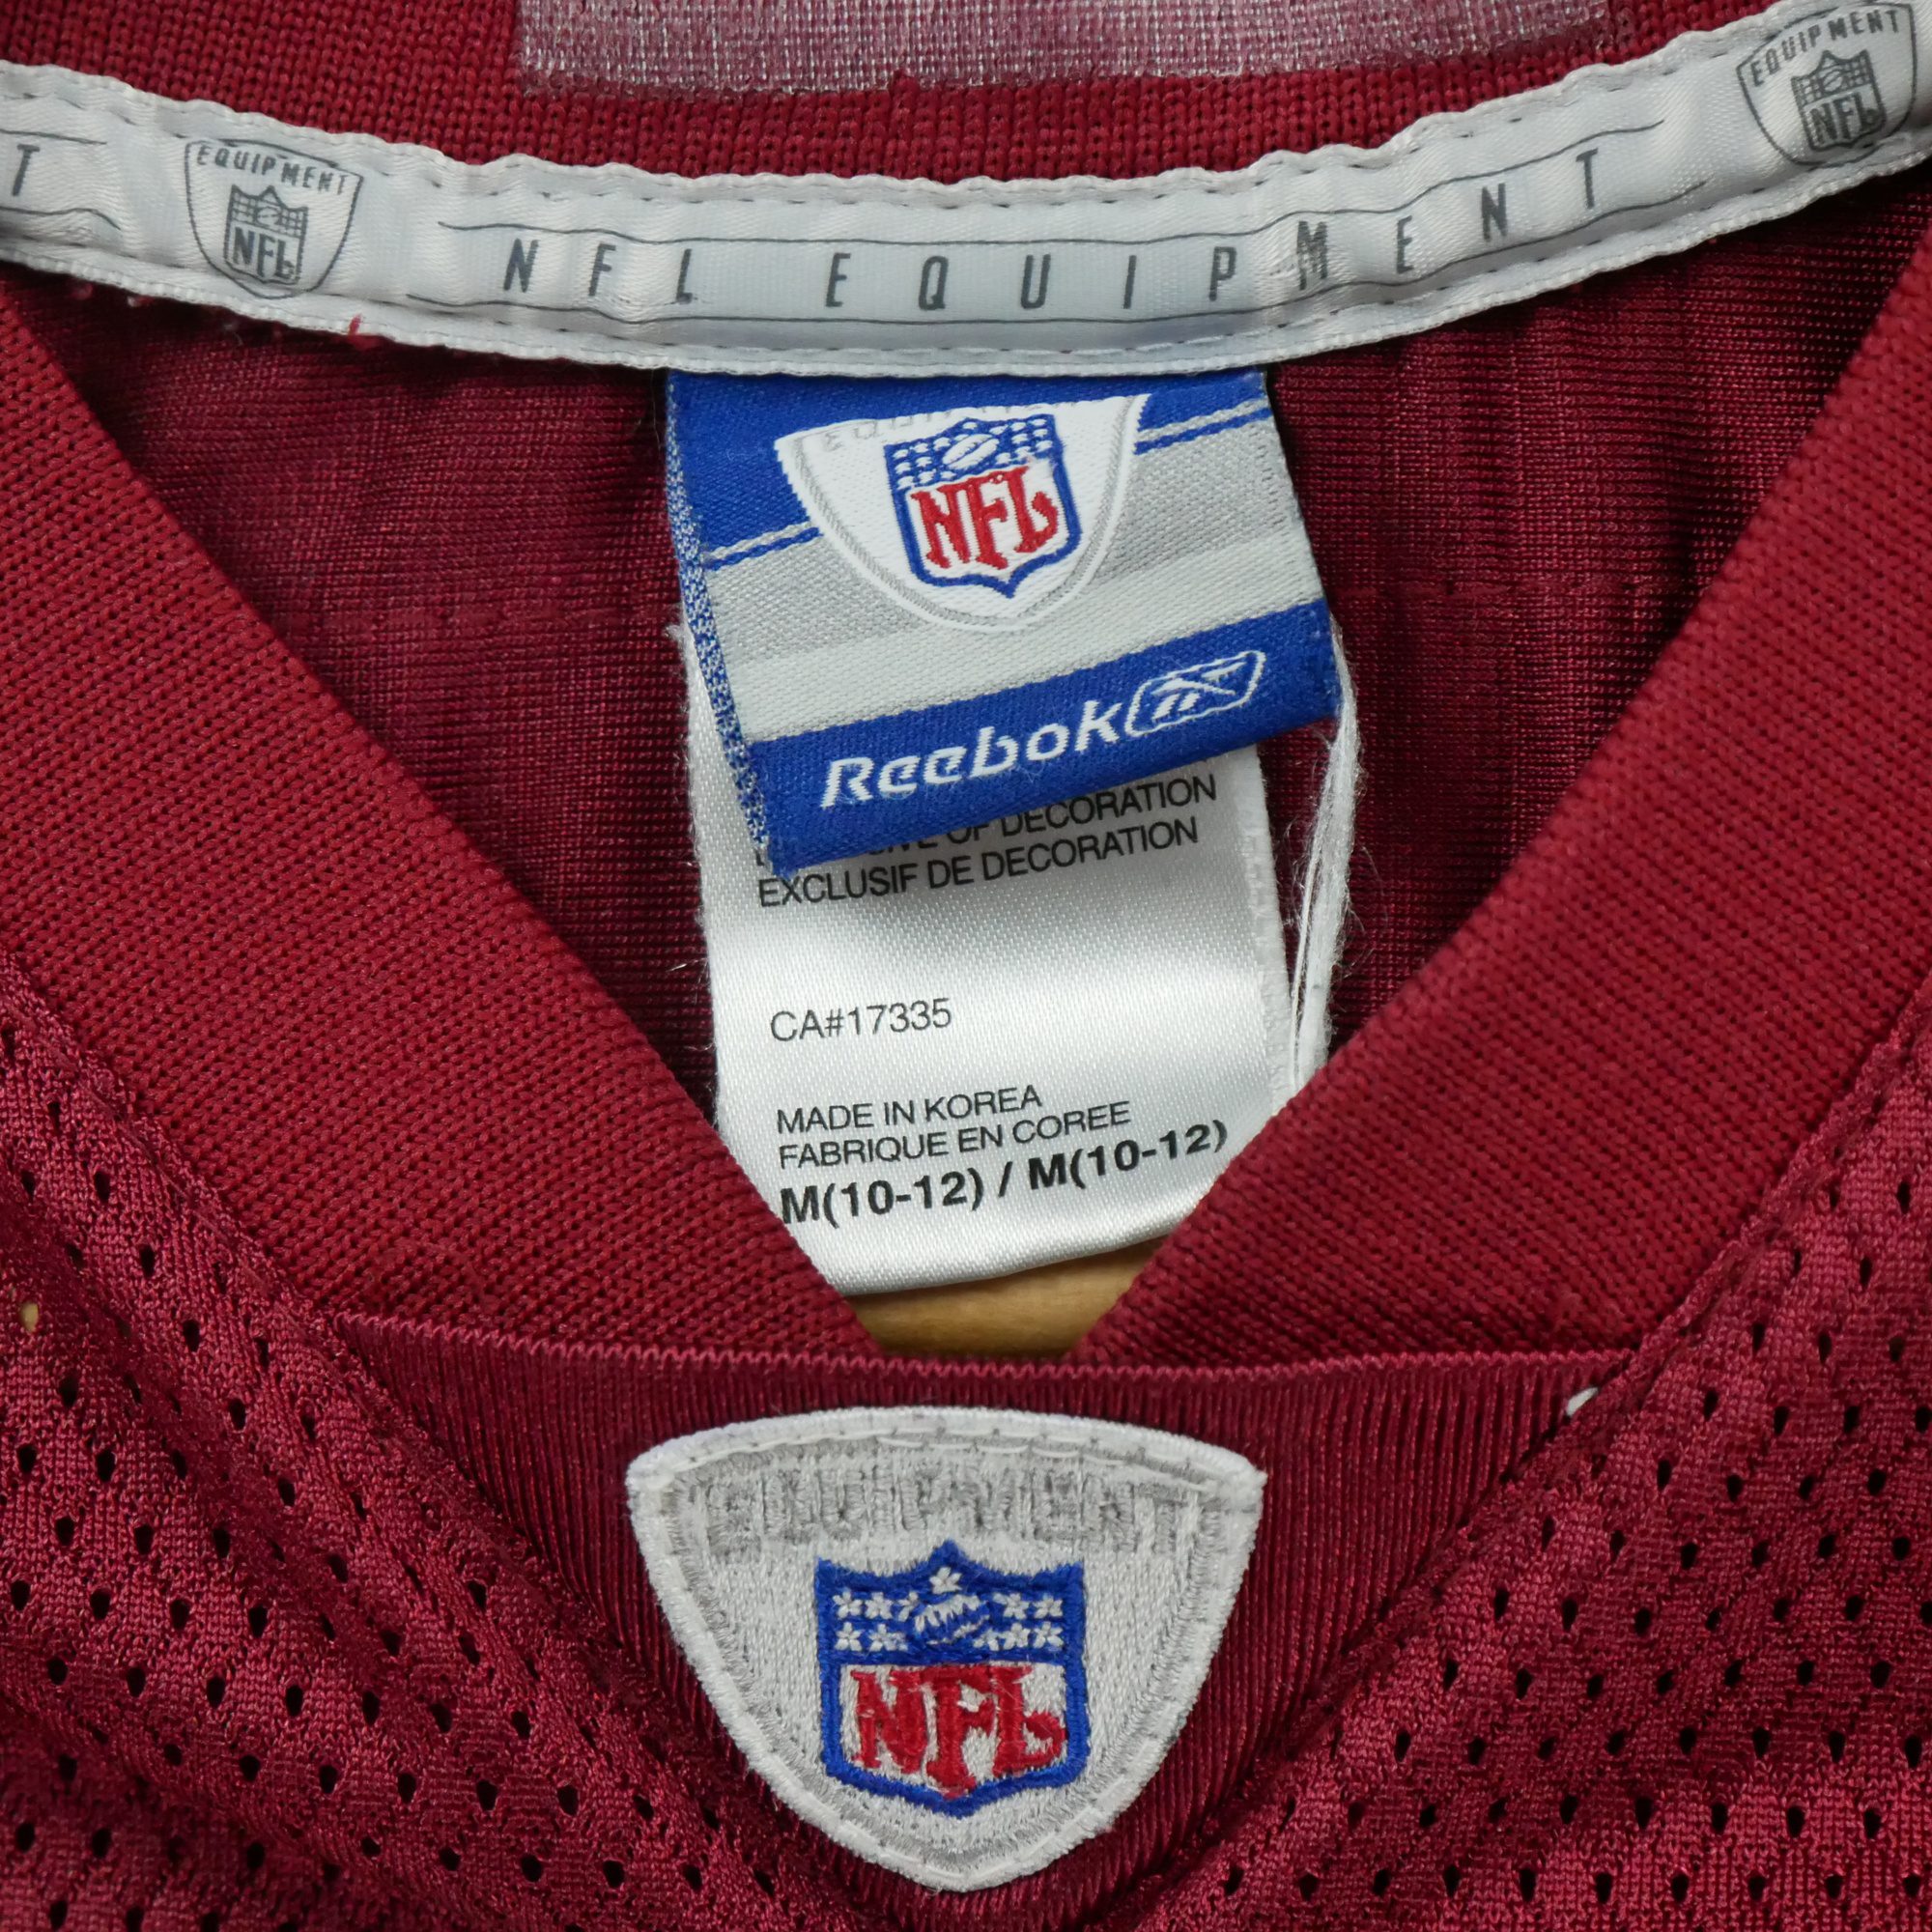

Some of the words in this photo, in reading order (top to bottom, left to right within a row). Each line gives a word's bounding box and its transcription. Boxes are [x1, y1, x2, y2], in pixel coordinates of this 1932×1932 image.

[1750, 10, 1899, 87] EQUIPMENT
[1810, 92, 1879, 144] NFL
[198, 146, 347, 196] EQUIPMENT
[233, 227, 296, 281] NFL
[503, 239, 693, 303] NFL
[825, 149, 1598, 310] EQUIPMENT
[911, 466, 1058, 570] NFL
[820, 699, 1122, 808] Reebok
[1001, 773, 1216, 837] DECORATION
[758, 862, 920, 907] EXCLUSIF
[927, 855, 974, 889] DE
[981, 816, 1198, 881] DECORATION
[770, 998, 952, 1041] CA#17335
[778, 1104, 874, 1133] MADE
[884, 1099, 915, 1124] IN
[924, 1085, 1042, 1121] KOREA
[779, 1132, 950, 1169] FABRIQUE
[959, 1124, 1002, 1153] EN
[1012, 1101, 1131, 1144] COREE
[780, 1168, 983, 1228] M(10-12)
[1028, 1120, 1228, 1191] M(10-12)
[850, 1665, 1065, 1800] NFL
